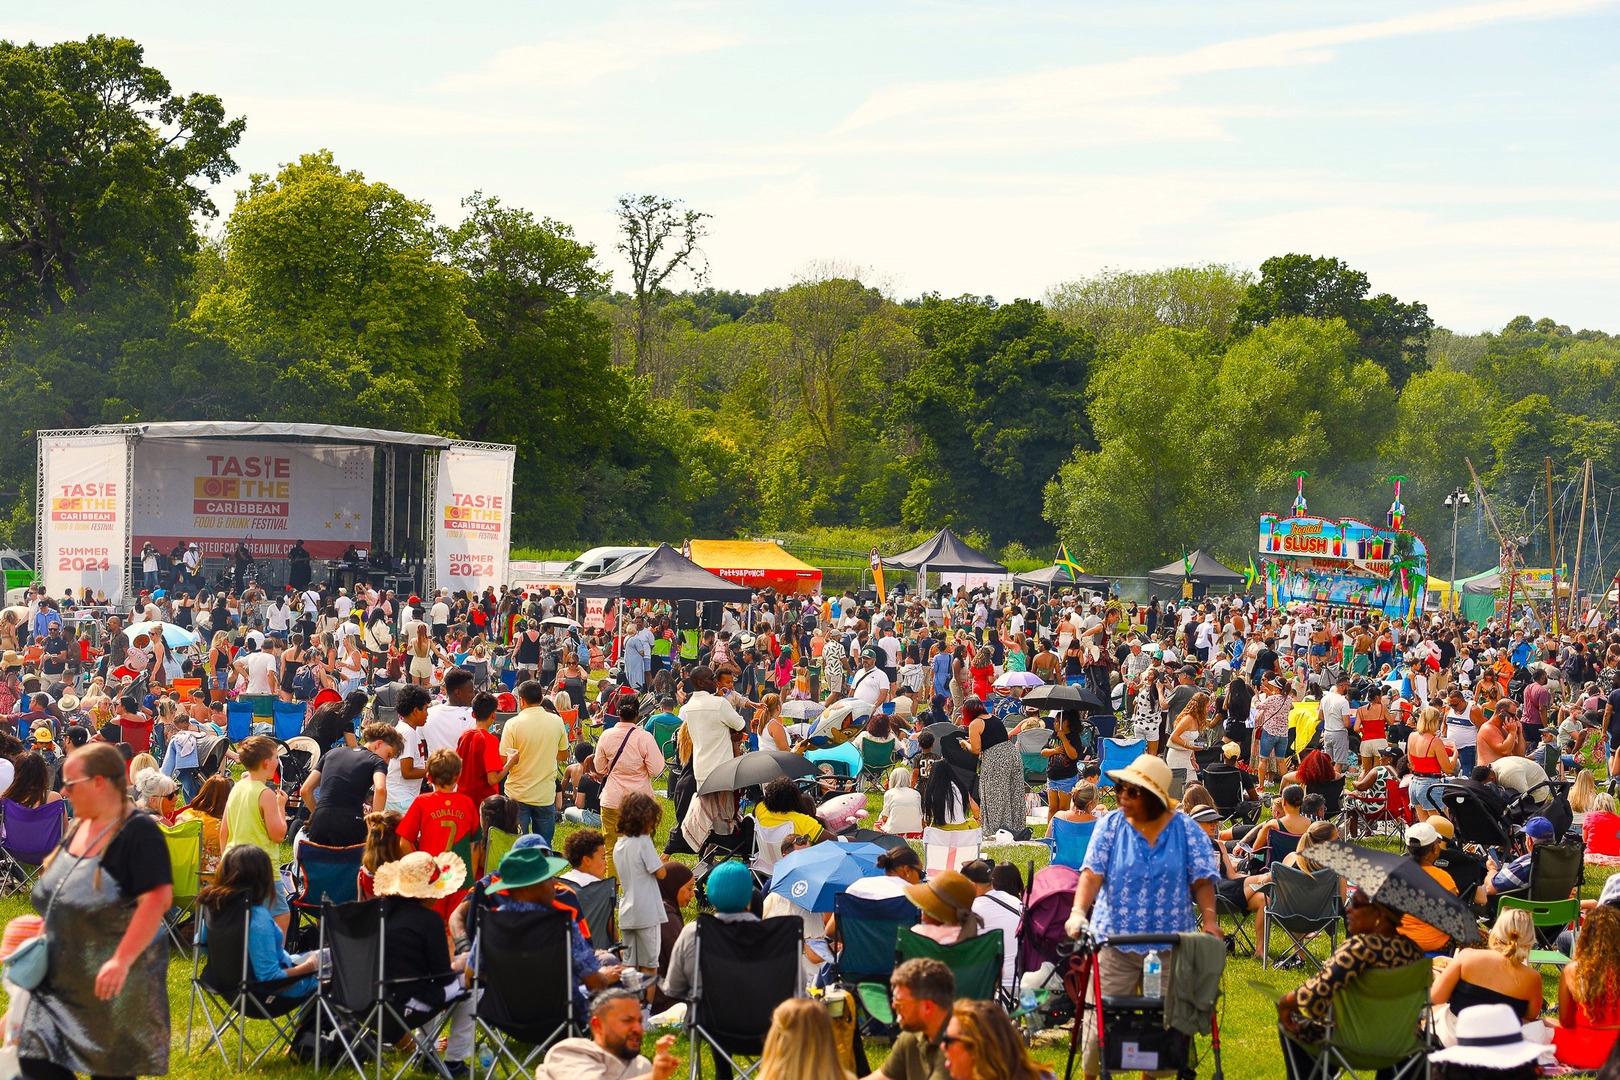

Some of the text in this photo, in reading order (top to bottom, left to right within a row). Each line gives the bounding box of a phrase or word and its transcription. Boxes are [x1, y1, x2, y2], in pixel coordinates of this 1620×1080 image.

[204, 478, 289, 498] OF THE
[59, 498, 117, 511] OF THE
[206, 502, 280, 514] CARIBBEAN
[60, 512, 111, 520] CARIBBEAN
[450, 507, 502, 521] OF THE
[91, 523, 114, 531] FESTIVAL
[193, 516, 216, 528] FOOD
[225, 517, 250, 529] DRINK
[251, 518, 288, 530] FESTIVAL
[451, 521, 496, 531] CARIBBEAN
[1290, 521, 1323, 538] Tropical
[478, 532, 499, 540] FESTIVAL
[1285, 535, 1328, 553] SLUSH
[59, 547, 109, 556] SUMMER
[450, 554, 493, 562] SUMMER
[59, 558, 109, 571] 2024
[450, 563, 494, 577] 2024
[1365, 562, 1390, 577] SLUSH
[430, 808, 465, 820] RONALDO
[441, 820, 457, 853] 7
